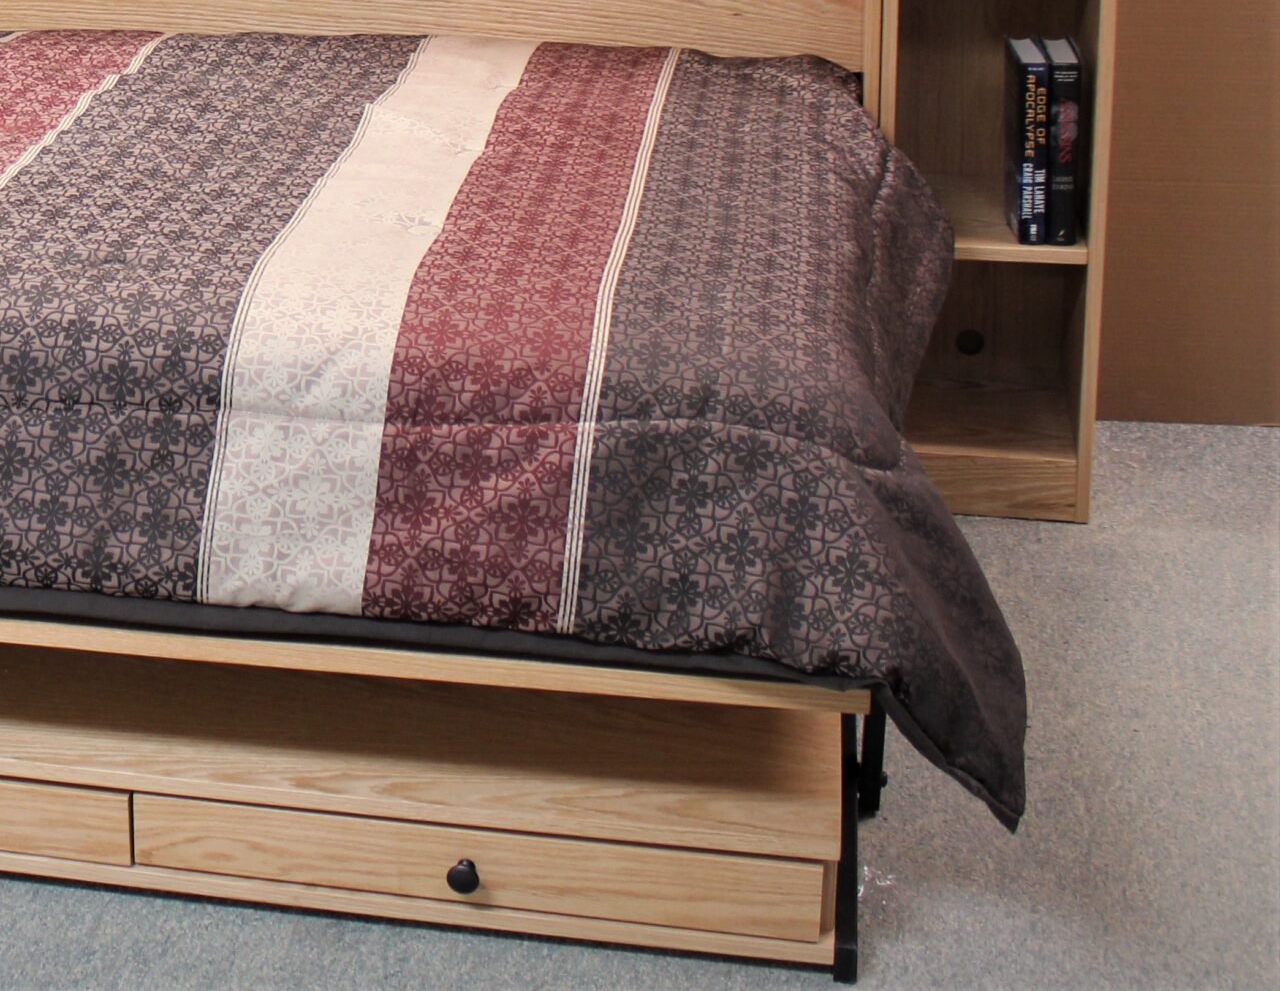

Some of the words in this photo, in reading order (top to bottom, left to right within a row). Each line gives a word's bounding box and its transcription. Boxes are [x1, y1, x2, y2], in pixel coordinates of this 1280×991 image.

[1024, 74, 1036, 158] APOCALYPSE
[1036, 87, 1047, 123] EDGE
[1036, 127, 1047, 145] OF
[1022, 162, 1034, 184] CRAIG
[1034, 168, 1046, 183] TIM
[1021, 185, 1033, 220] PARSHALL
